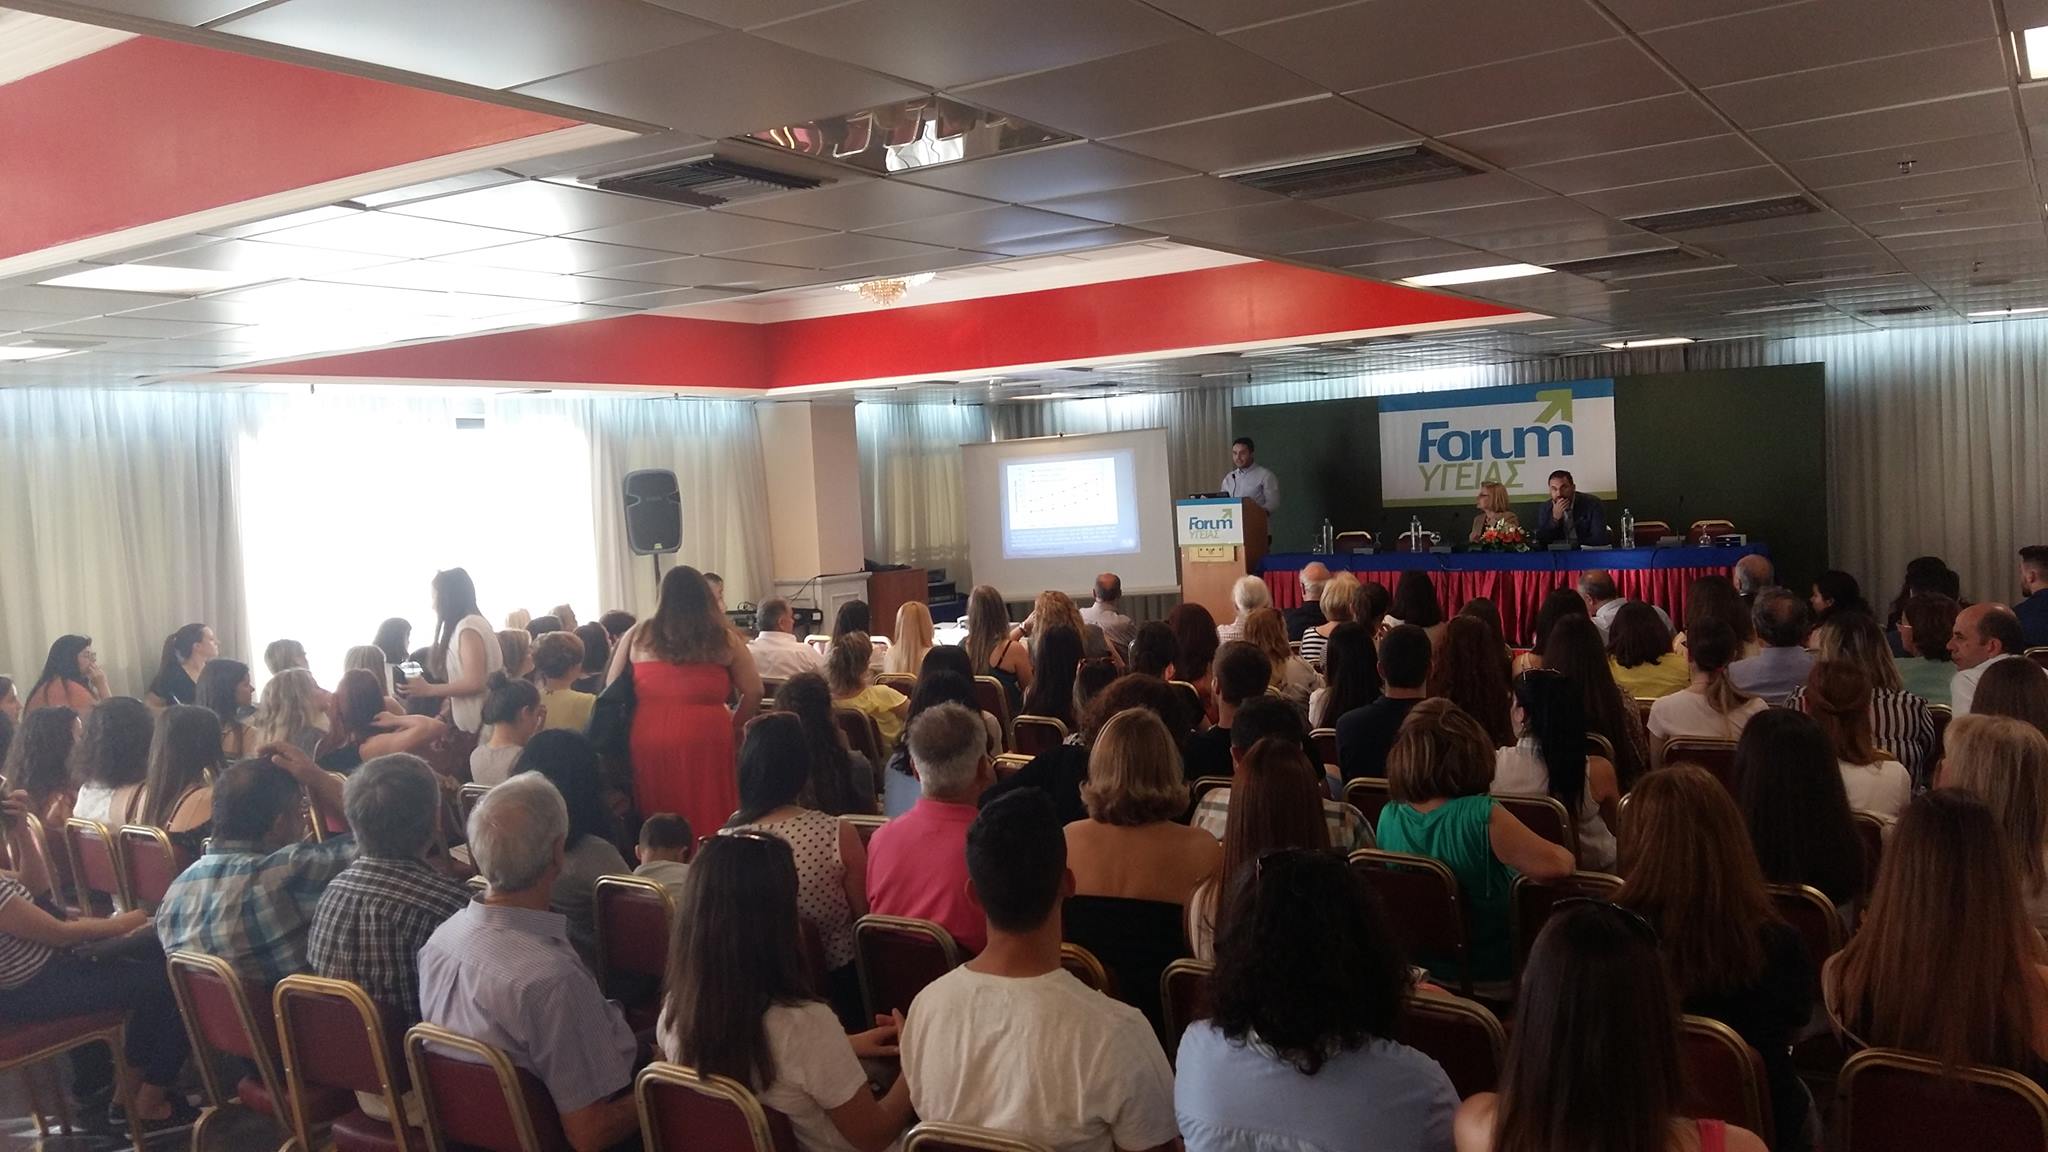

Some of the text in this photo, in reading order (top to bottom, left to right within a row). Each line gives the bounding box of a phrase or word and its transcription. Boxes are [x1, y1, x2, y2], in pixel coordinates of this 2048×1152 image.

[1418, 421, 1574, 463] Forum
[1418, 460, 1526, 492] ΥΓΕΙΑΣ
[1189, 517, 1233, 530] Forum
